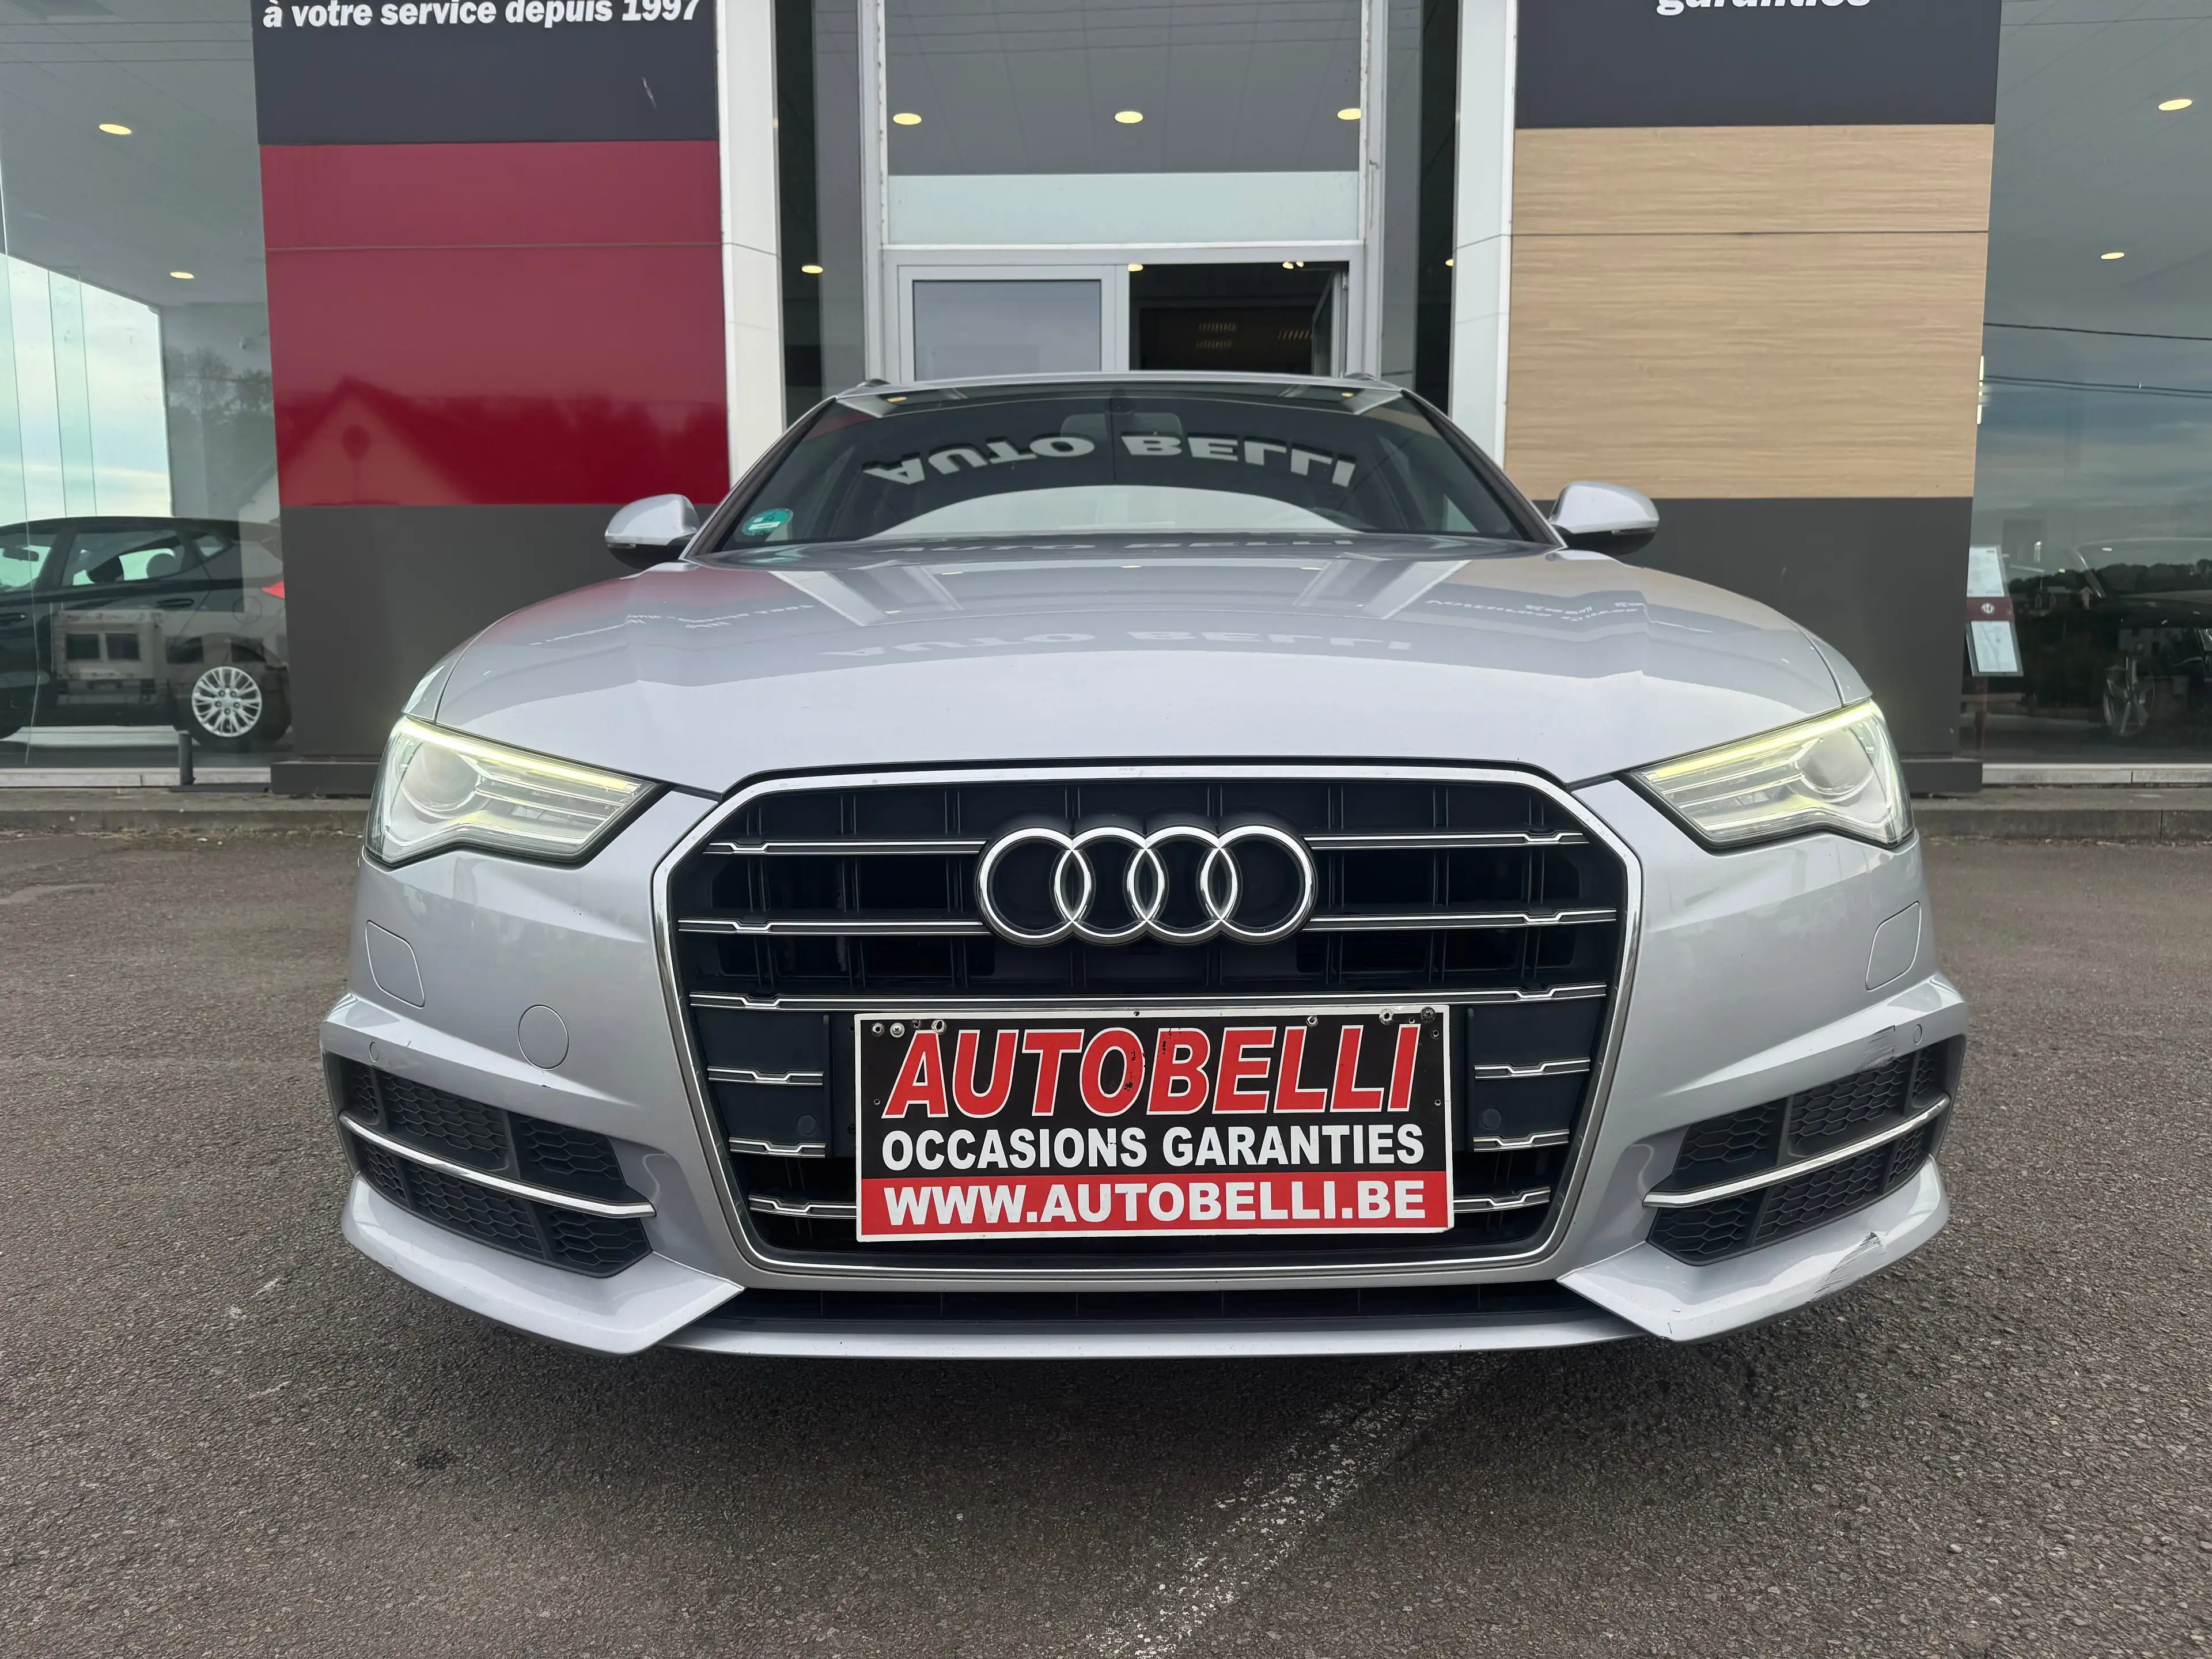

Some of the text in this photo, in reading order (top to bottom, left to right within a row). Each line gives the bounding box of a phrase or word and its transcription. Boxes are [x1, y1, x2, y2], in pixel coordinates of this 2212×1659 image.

[263, 0, 699, 28] à votre service depuis 1997
[881, 1024, 1421, 1119] AUTOBELLI
[882, 1123, 1425, 1171] OCCASIONS GARANTIES
[884, 1180, 1426, 1226] WWW.AUTOBELLI.BE
